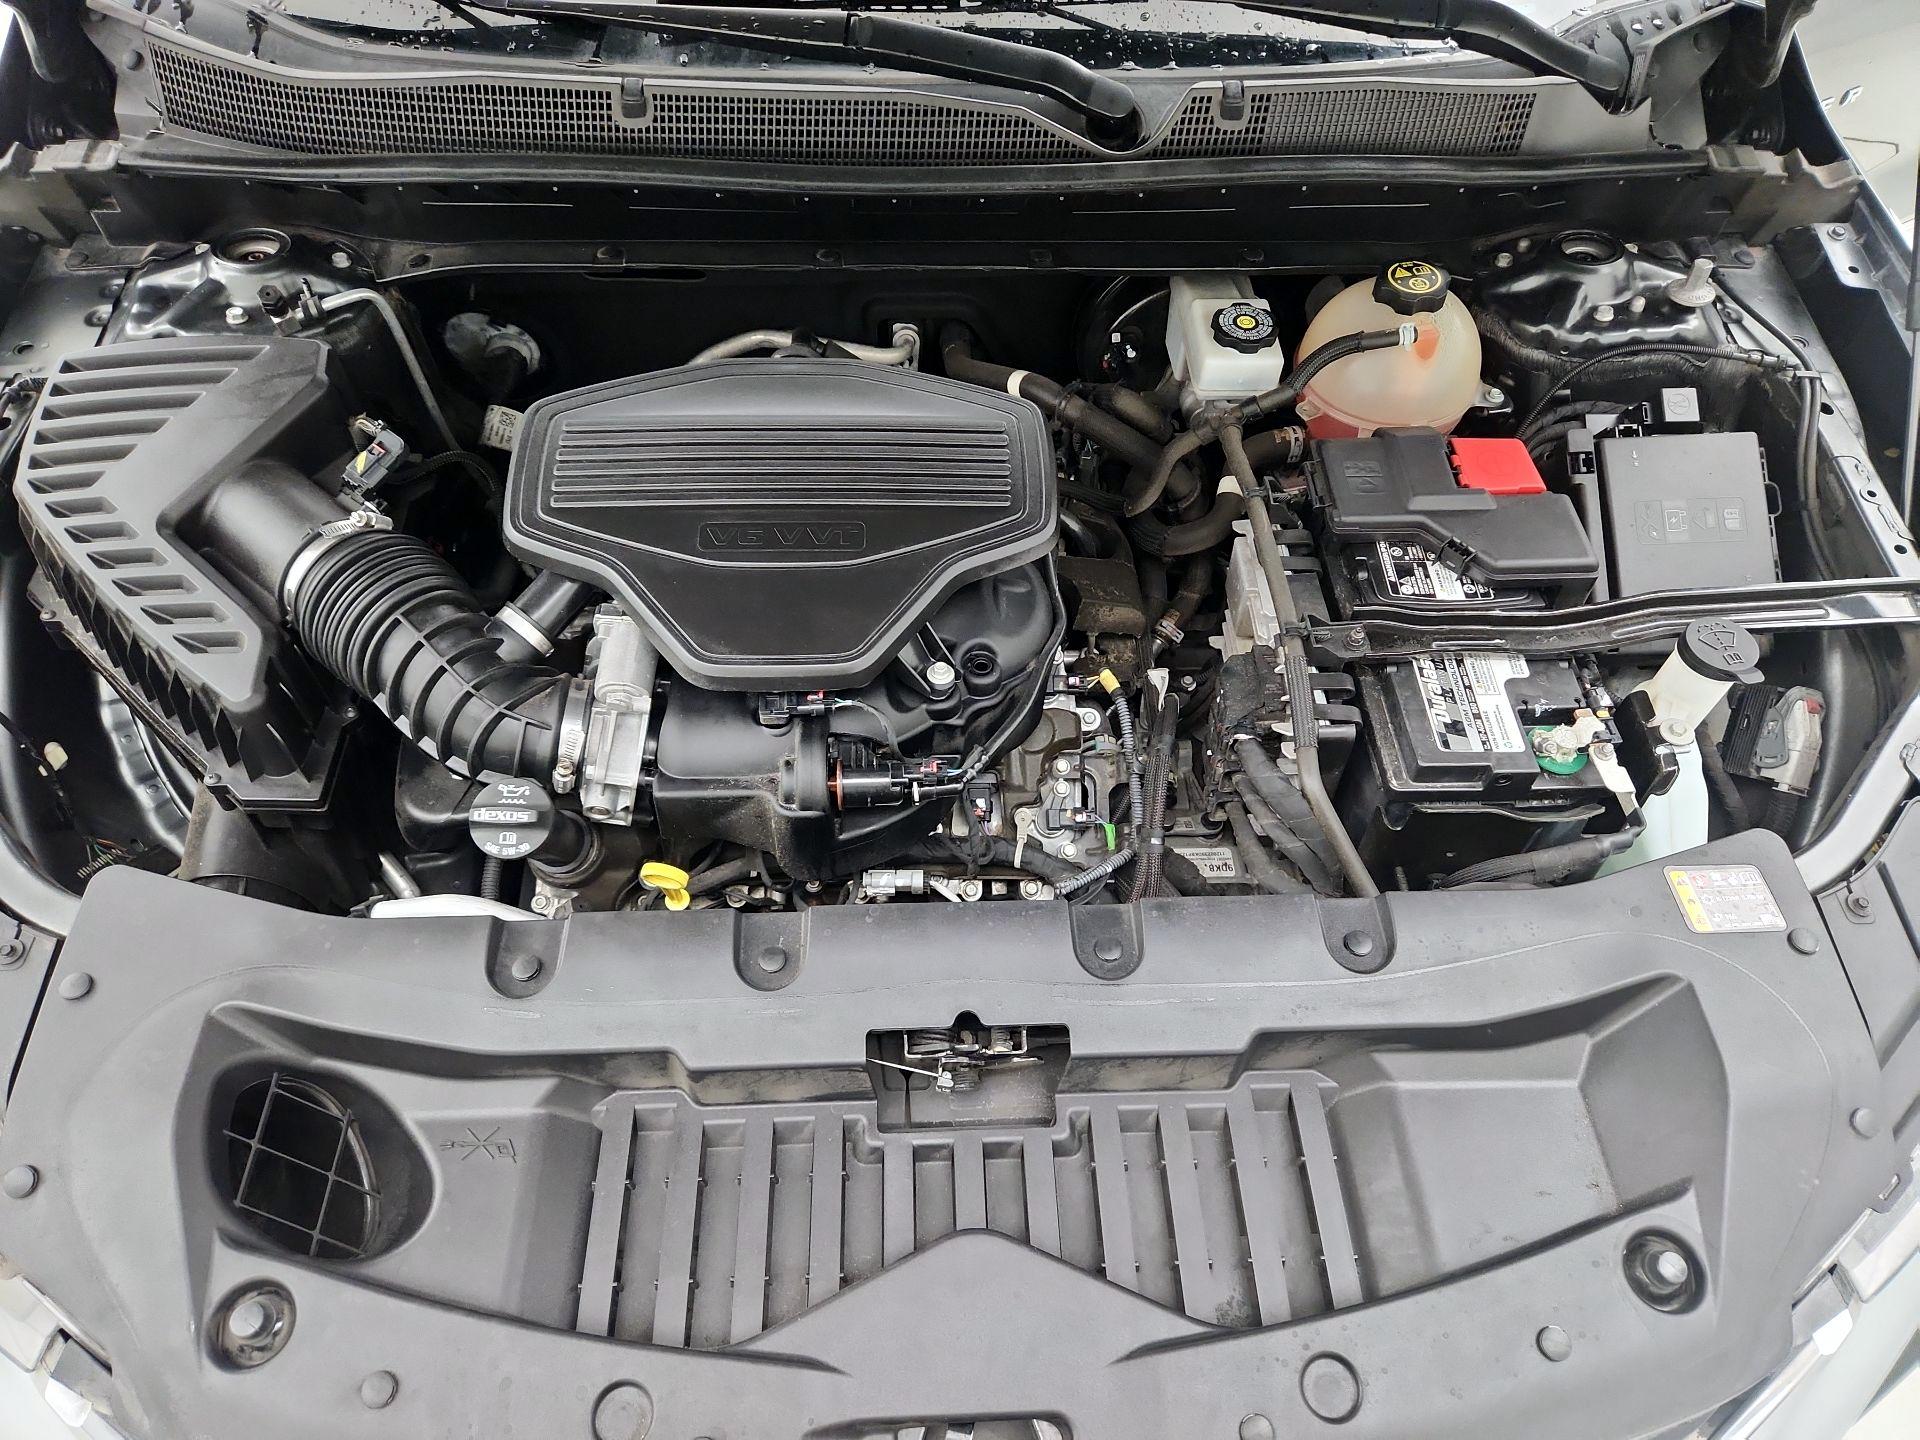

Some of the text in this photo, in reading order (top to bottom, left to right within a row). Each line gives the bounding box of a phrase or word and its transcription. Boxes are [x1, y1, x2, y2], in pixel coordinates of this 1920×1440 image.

[706, 527, 860, 546] V6 VVT
[1419, 657, 1452, 723] Duralas
[1447, 657, 1466, 706] TECHNOLOG
[473, 808, 531, 821] dexos
[484, 842, 530, 855] SAE 5W-30
